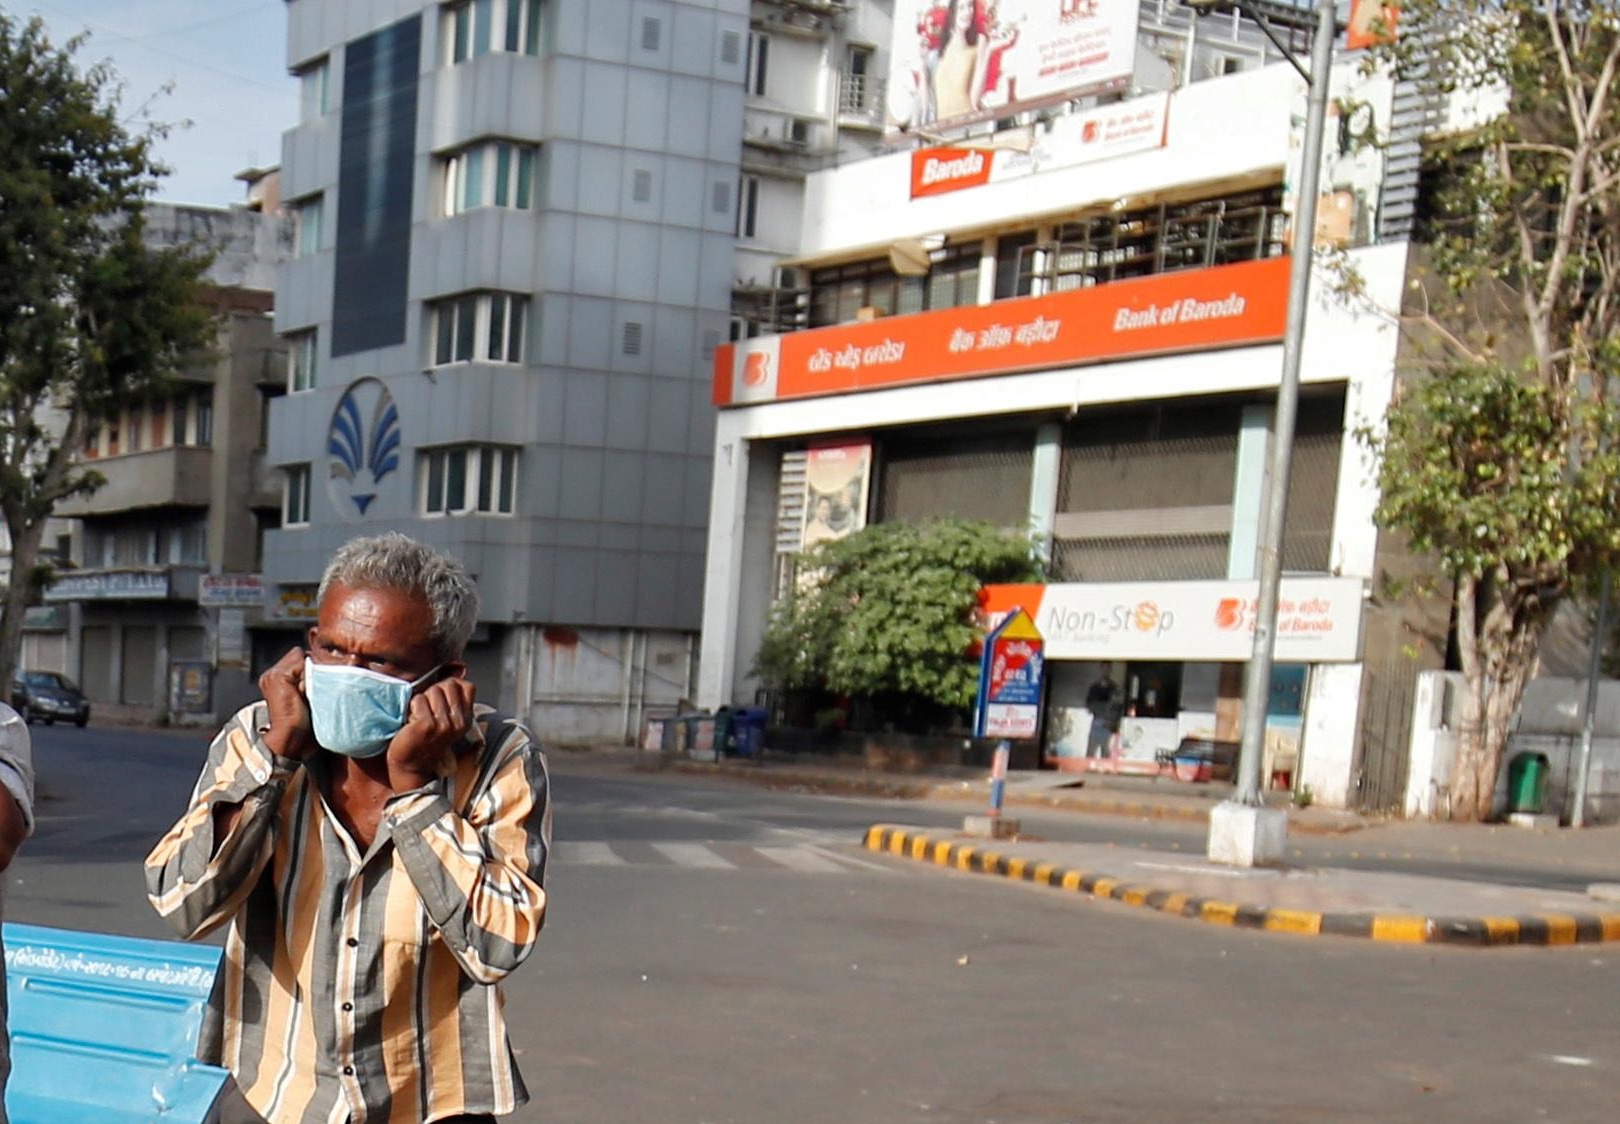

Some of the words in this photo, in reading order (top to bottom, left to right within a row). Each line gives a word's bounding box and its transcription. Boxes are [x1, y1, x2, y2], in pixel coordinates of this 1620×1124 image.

[921, 152, 984, 185] Baroda
[1114, 304, 1157, 331] Bank
[1159, 299, 1180, 325] of
[1180, 292, 1245, 322] Baroda
